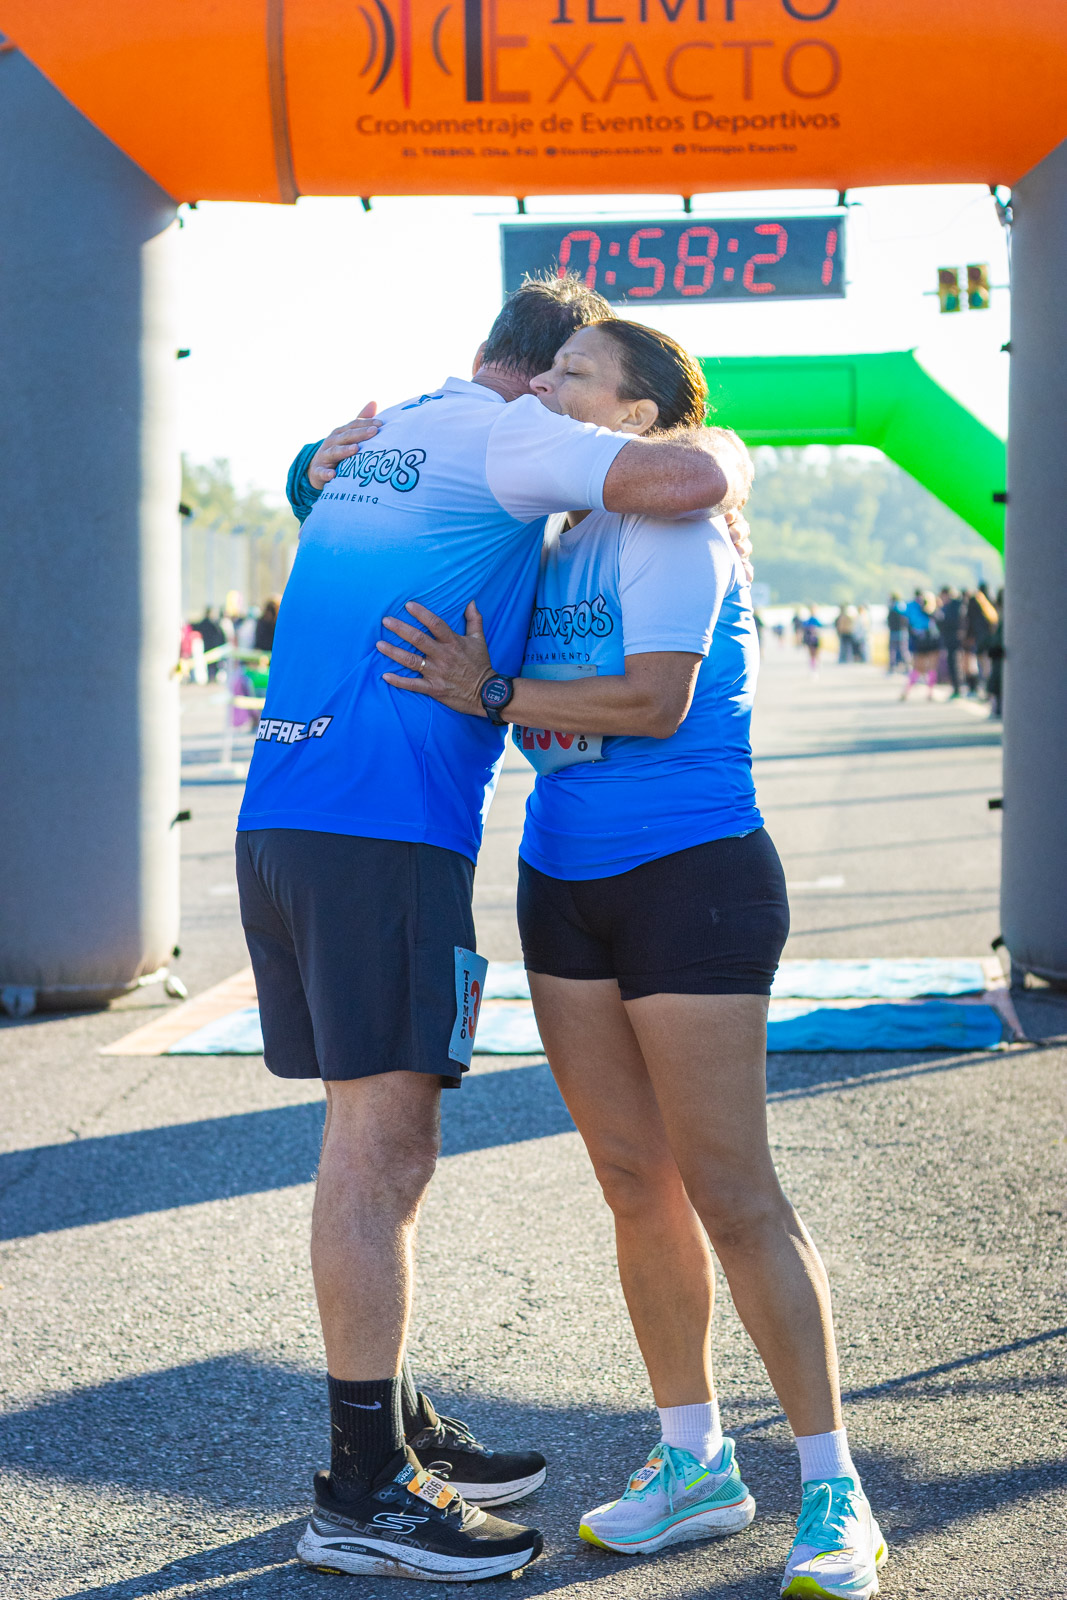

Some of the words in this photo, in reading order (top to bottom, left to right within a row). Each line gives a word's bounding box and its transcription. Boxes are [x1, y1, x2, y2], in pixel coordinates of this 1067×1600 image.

[356, 115, 534, 139] Cronometraje
[540, 113, 574, 133] de
[581, 112, 685, 133] Eventos
[693, 110, 841, 135] Deportivos
[460, 969, 470, 1039] TIEMPO
[422, 1480, 443, 1499] 366
